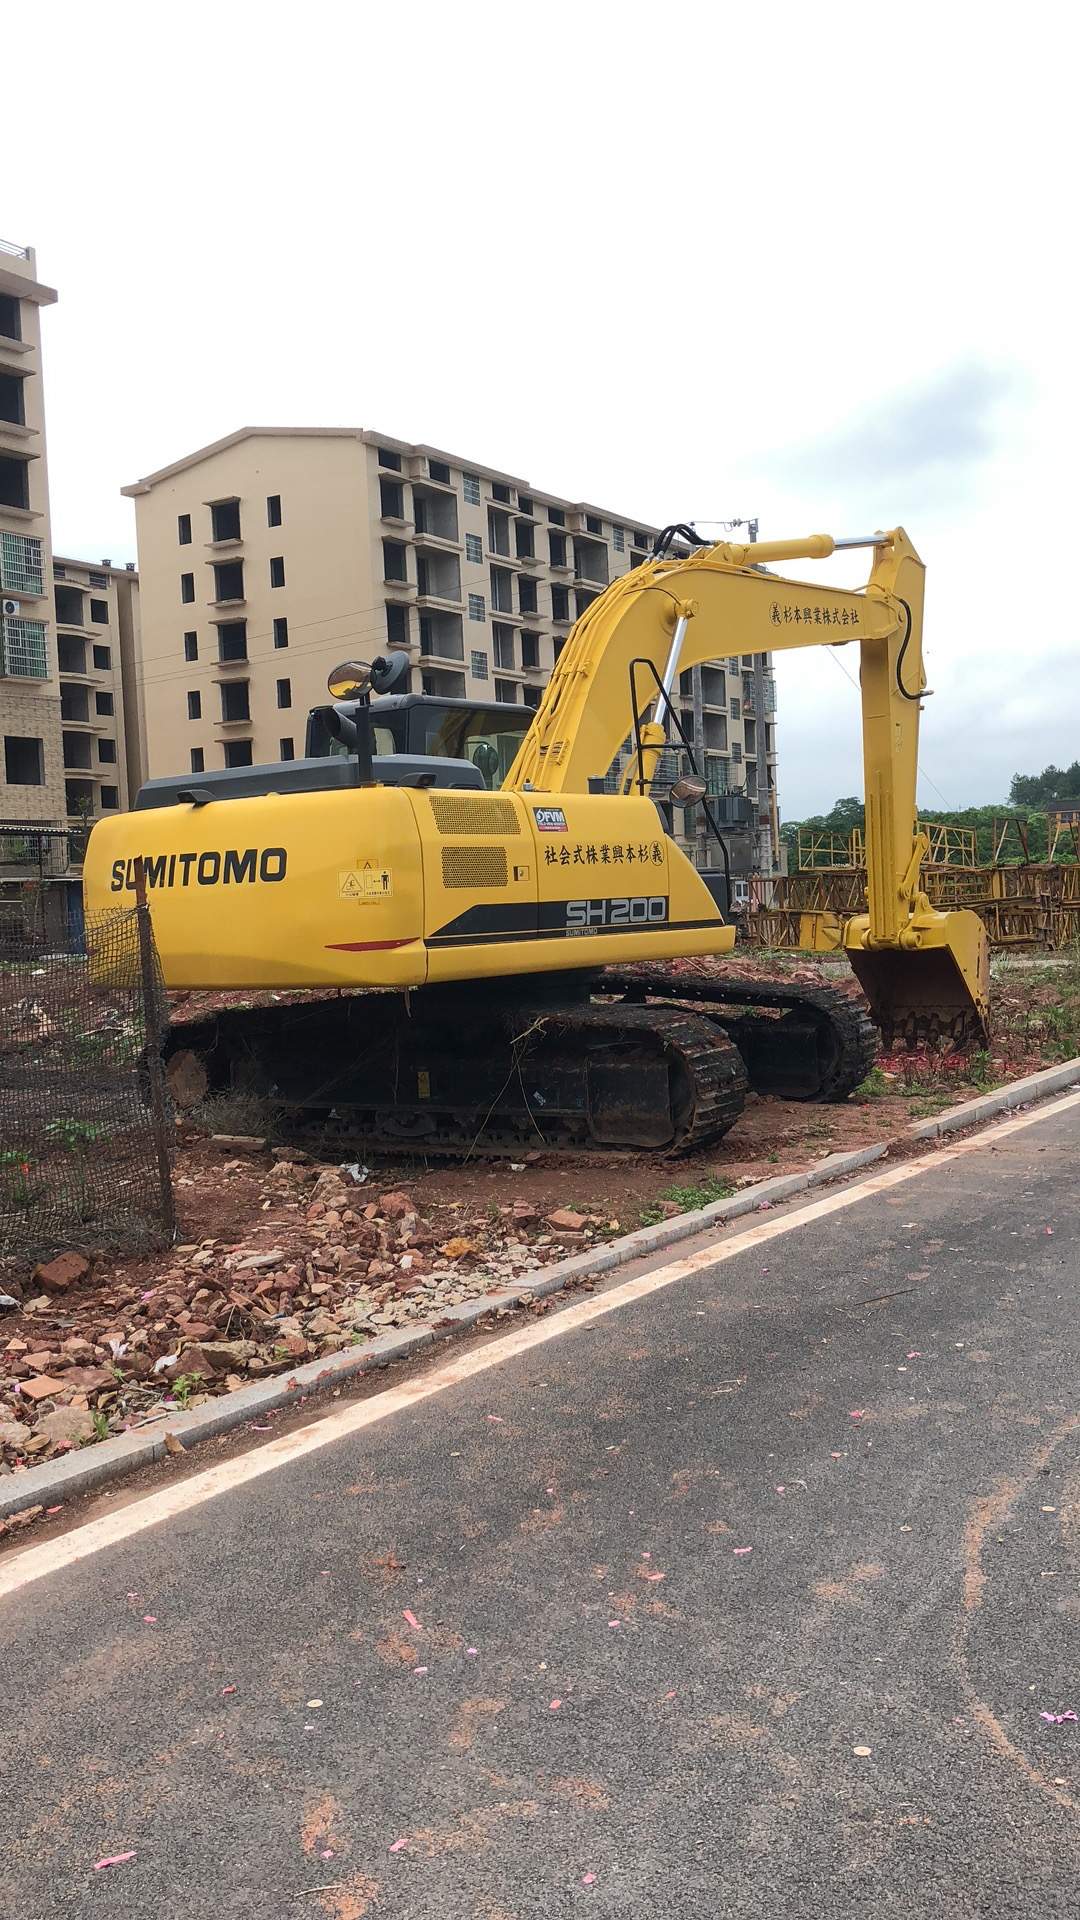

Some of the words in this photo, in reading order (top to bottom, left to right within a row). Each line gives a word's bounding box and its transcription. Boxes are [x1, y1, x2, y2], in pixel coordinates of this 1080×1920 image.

[111, 847, 288, 892] SUMITOMO
[566, 896, 666, 927] SH200
[565, 927, 598, 937] SUMITOMO
